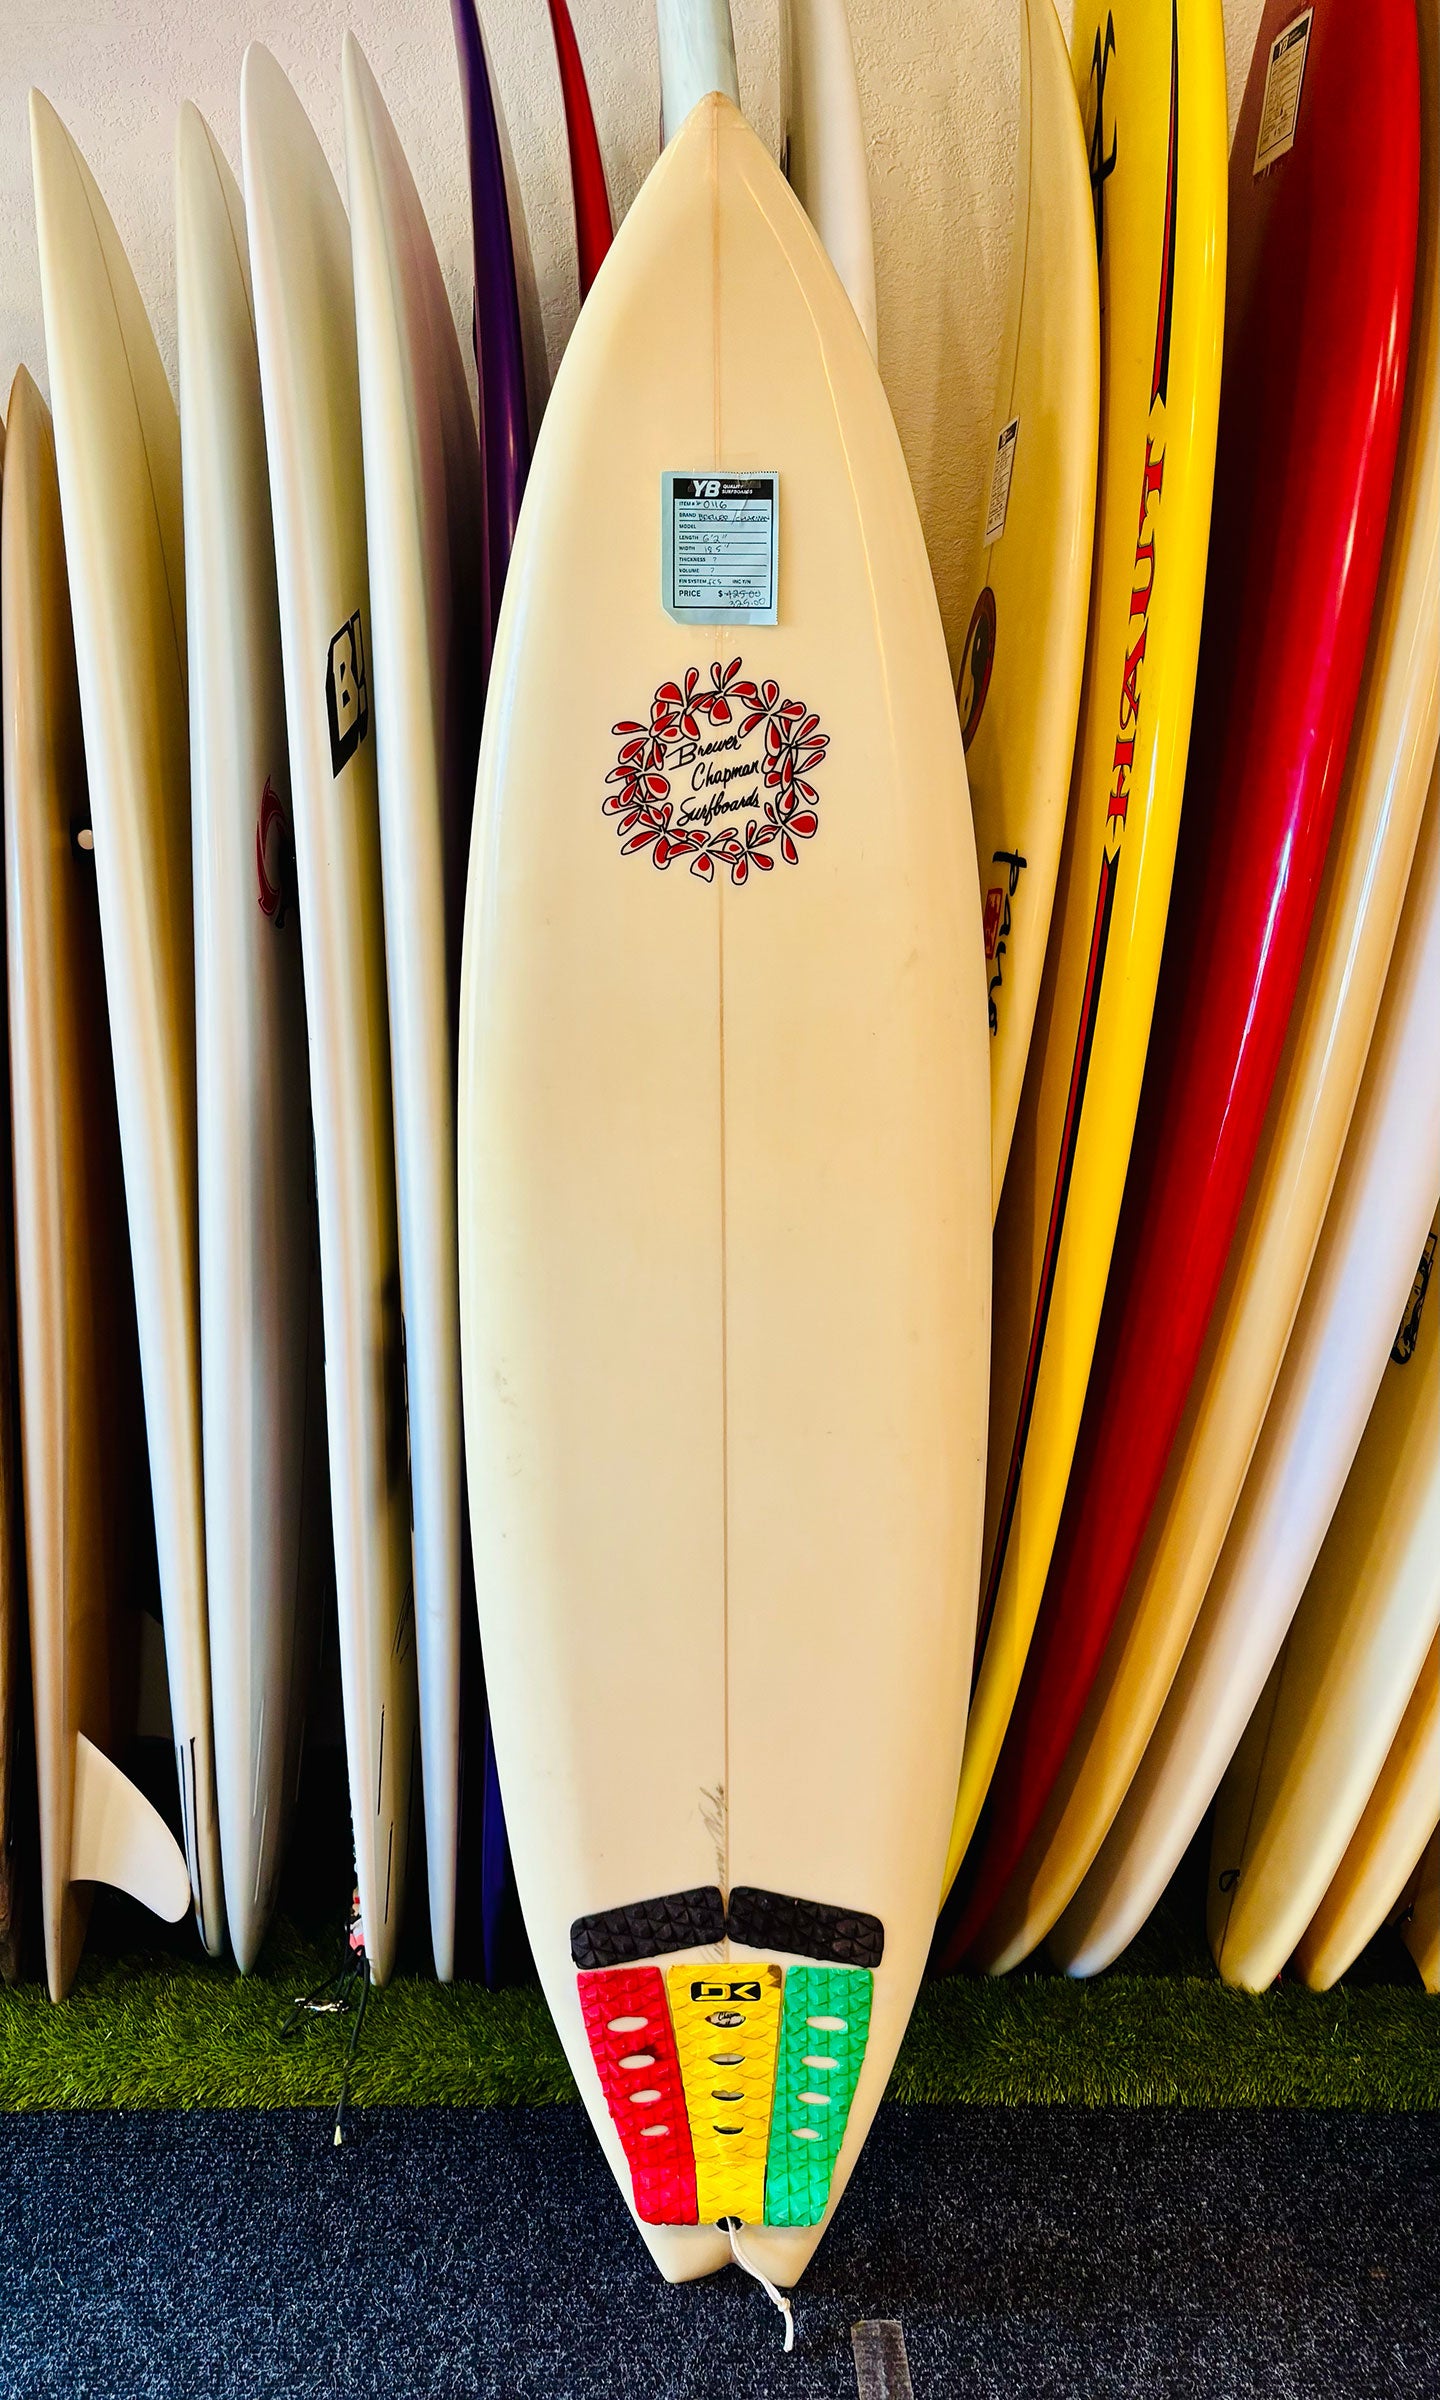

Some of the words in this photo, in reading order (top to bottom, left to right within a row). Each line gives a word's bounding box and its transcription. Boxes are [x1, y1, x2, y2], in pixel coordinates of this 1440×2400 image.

[692, 480, 721, 498] YB
[679, 590, 701, 598] PRICE
[1106, 434, 1166, 842] HAUT
[665, 735, 742, 770] Brewer
[691, 760, 760, 791] Chapman
[677, 786, 760, 826] Surfboards
